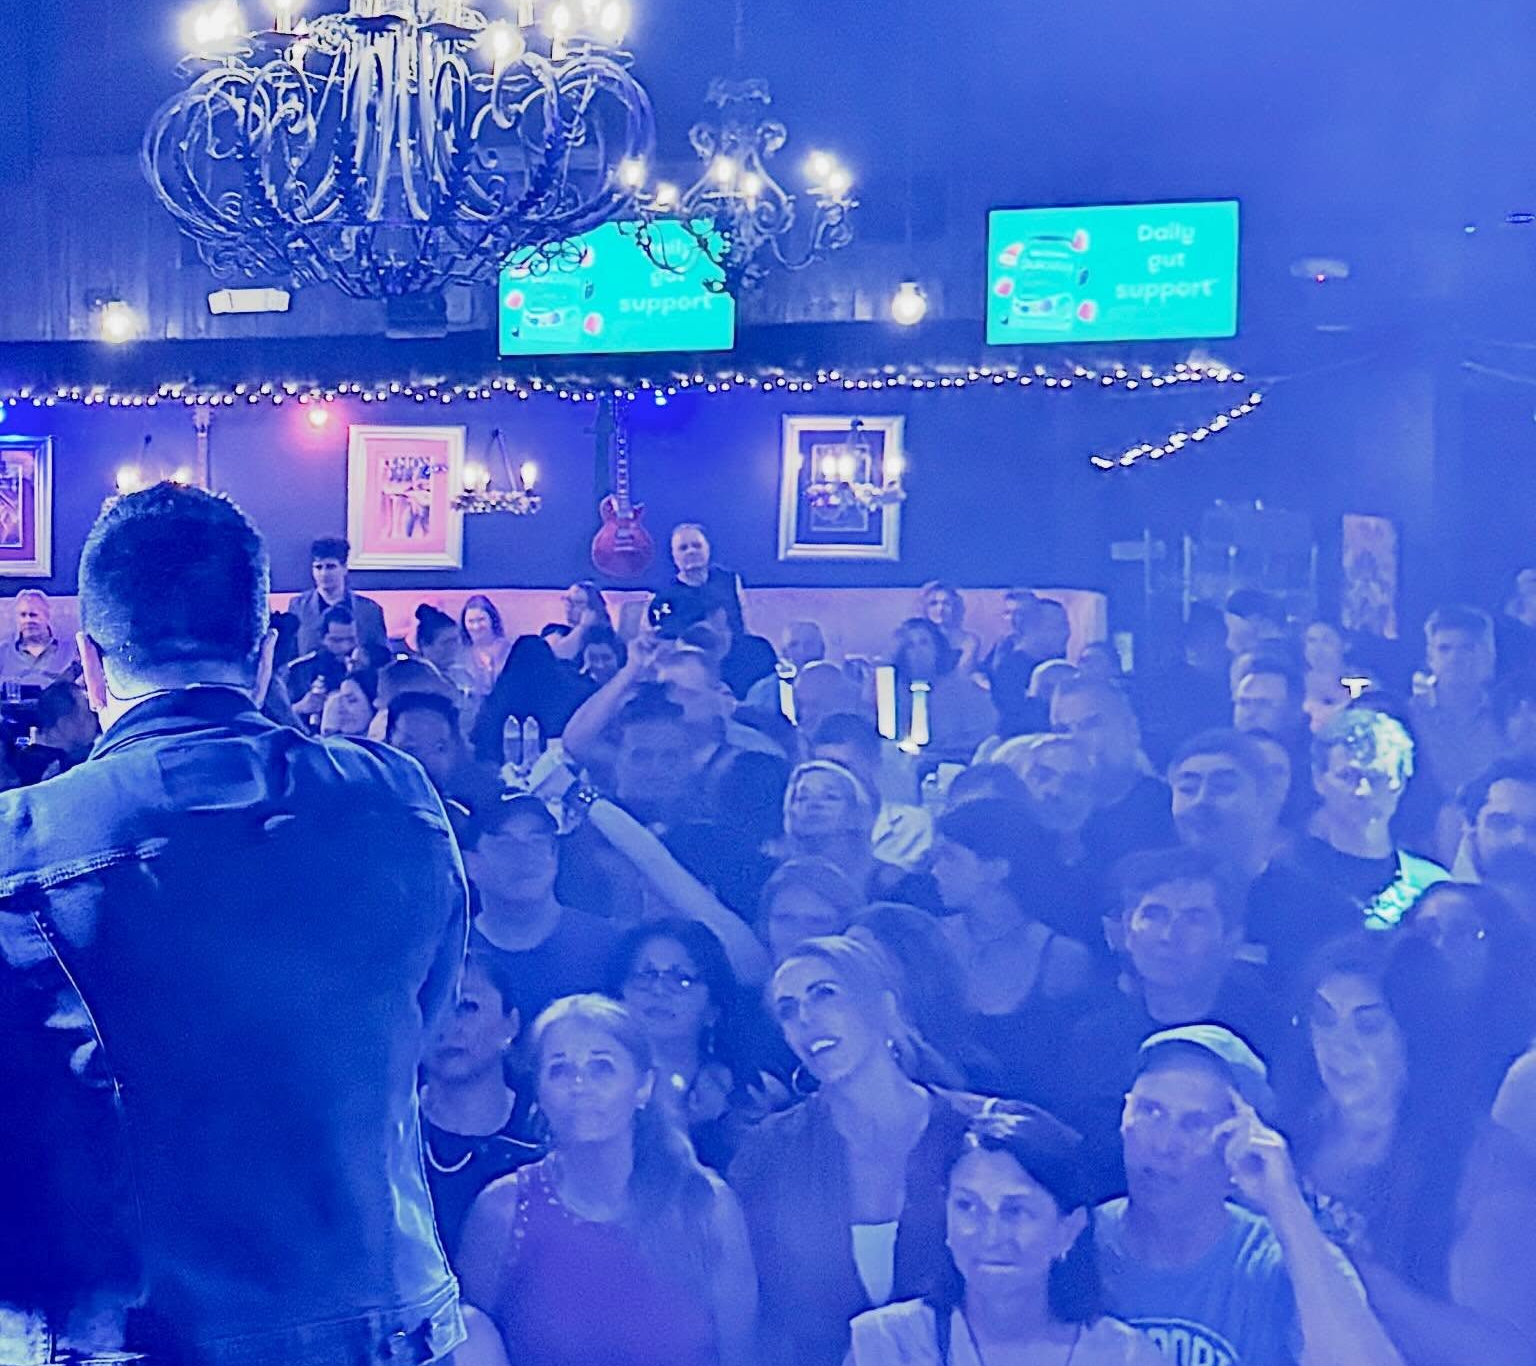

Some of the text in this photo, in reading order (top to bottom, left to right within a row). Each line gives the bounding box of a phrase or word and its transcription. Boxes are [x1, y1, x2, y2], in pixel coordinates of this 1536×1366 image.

[1137, 222, 1197, 245] Daily
[1148, 251, 1186, 275] gut
[1115, 277, 1219, 306] support
[619, 295, 714, 316] support
